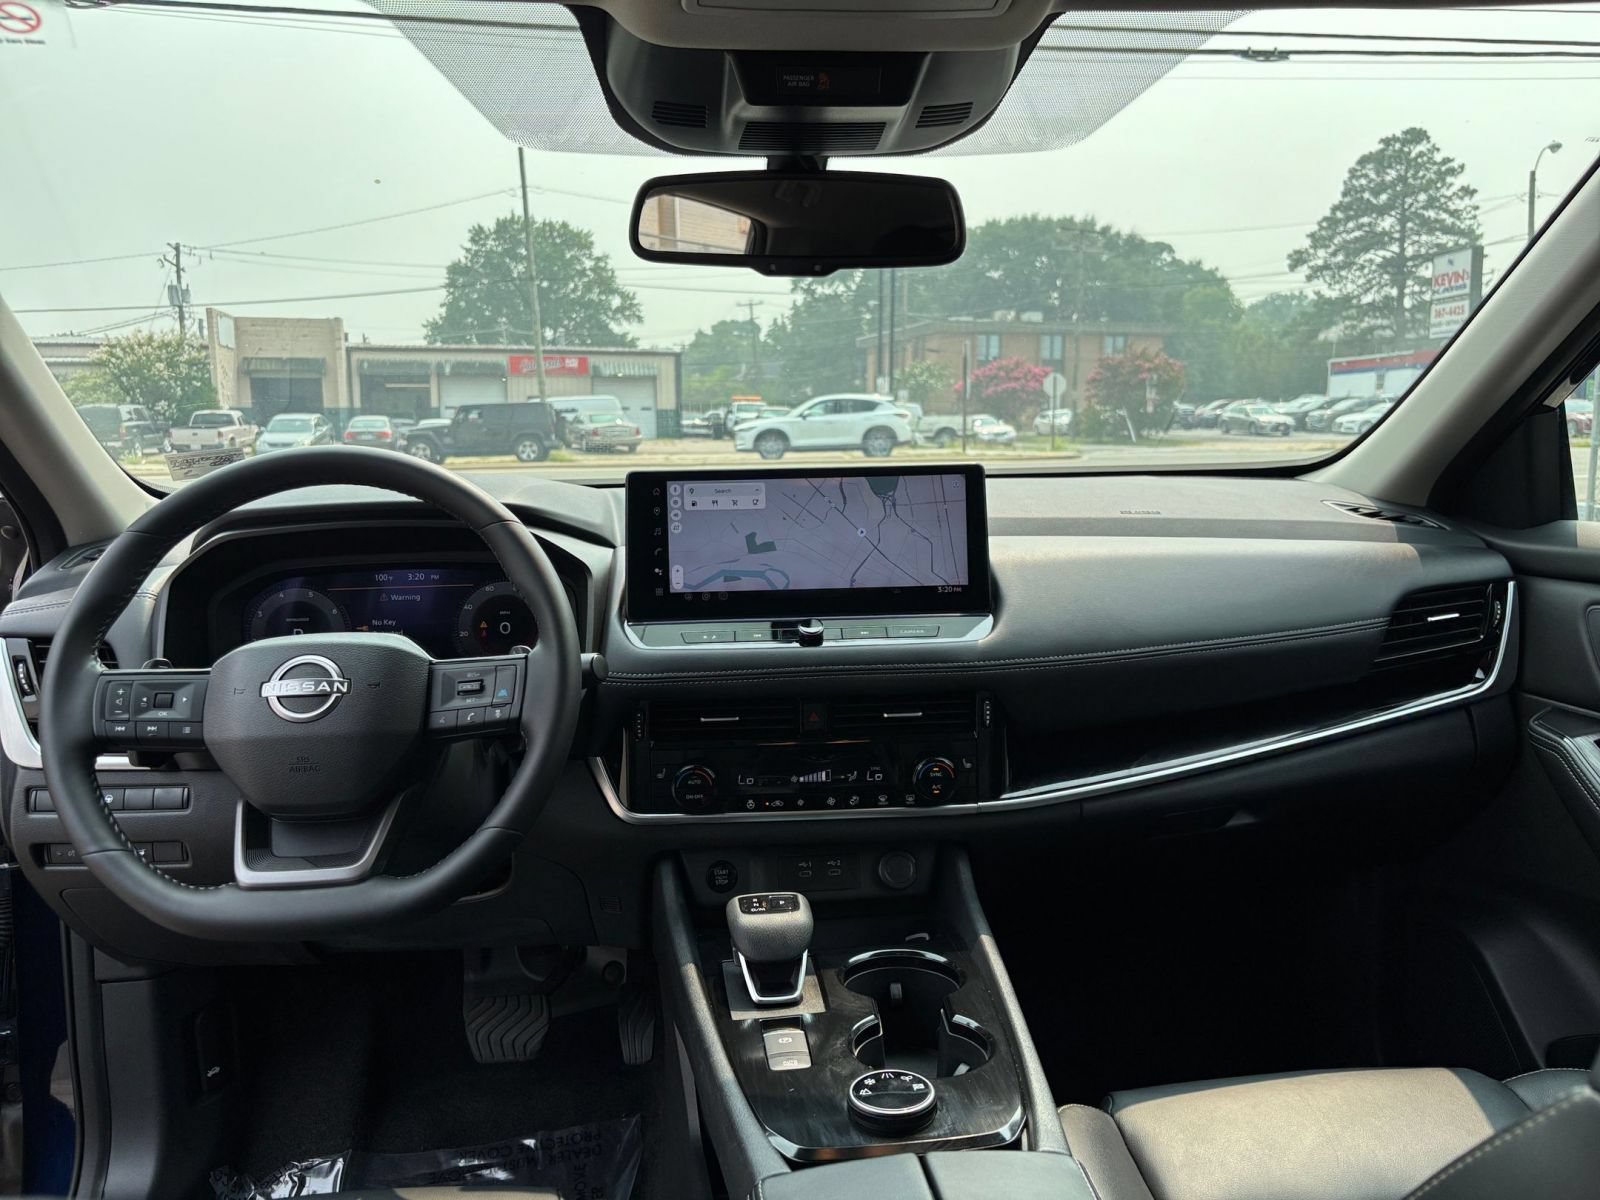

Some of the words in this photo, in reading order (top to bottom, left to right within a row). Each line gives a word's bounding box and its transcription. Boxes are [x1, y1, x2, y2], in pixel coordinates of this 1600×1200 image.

[407, 573, 425, 581] 3:20
[390, 593, 421, 602] Warning
[383, 619, 397, 627] Key
[265, 681, 348, 693] NISSAN
